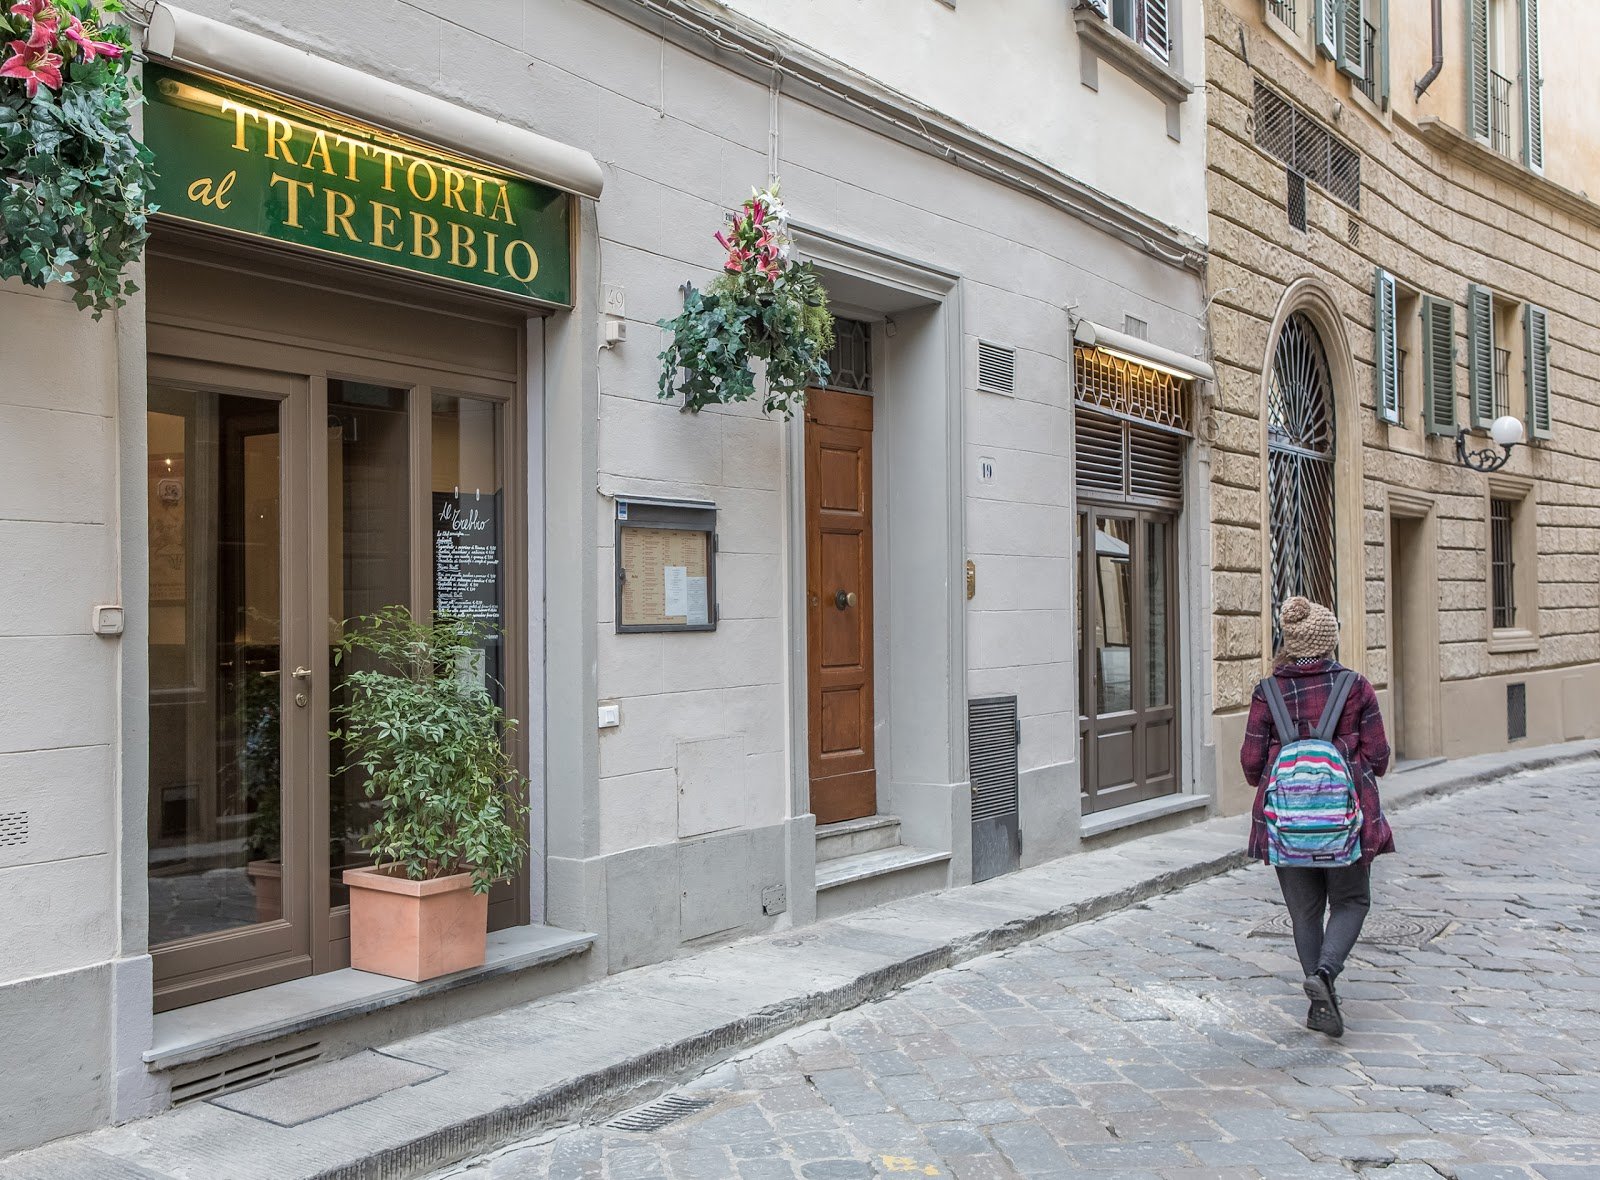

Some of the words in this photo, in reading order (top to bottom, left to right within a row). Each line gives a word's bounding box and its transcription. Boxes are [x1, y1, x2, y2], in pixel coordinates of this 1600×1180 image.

[221, 99, 517, 226] TRATTORIA
[187, 170, 237, 211] al
[270, 171, 539, 283] TREBBIO
